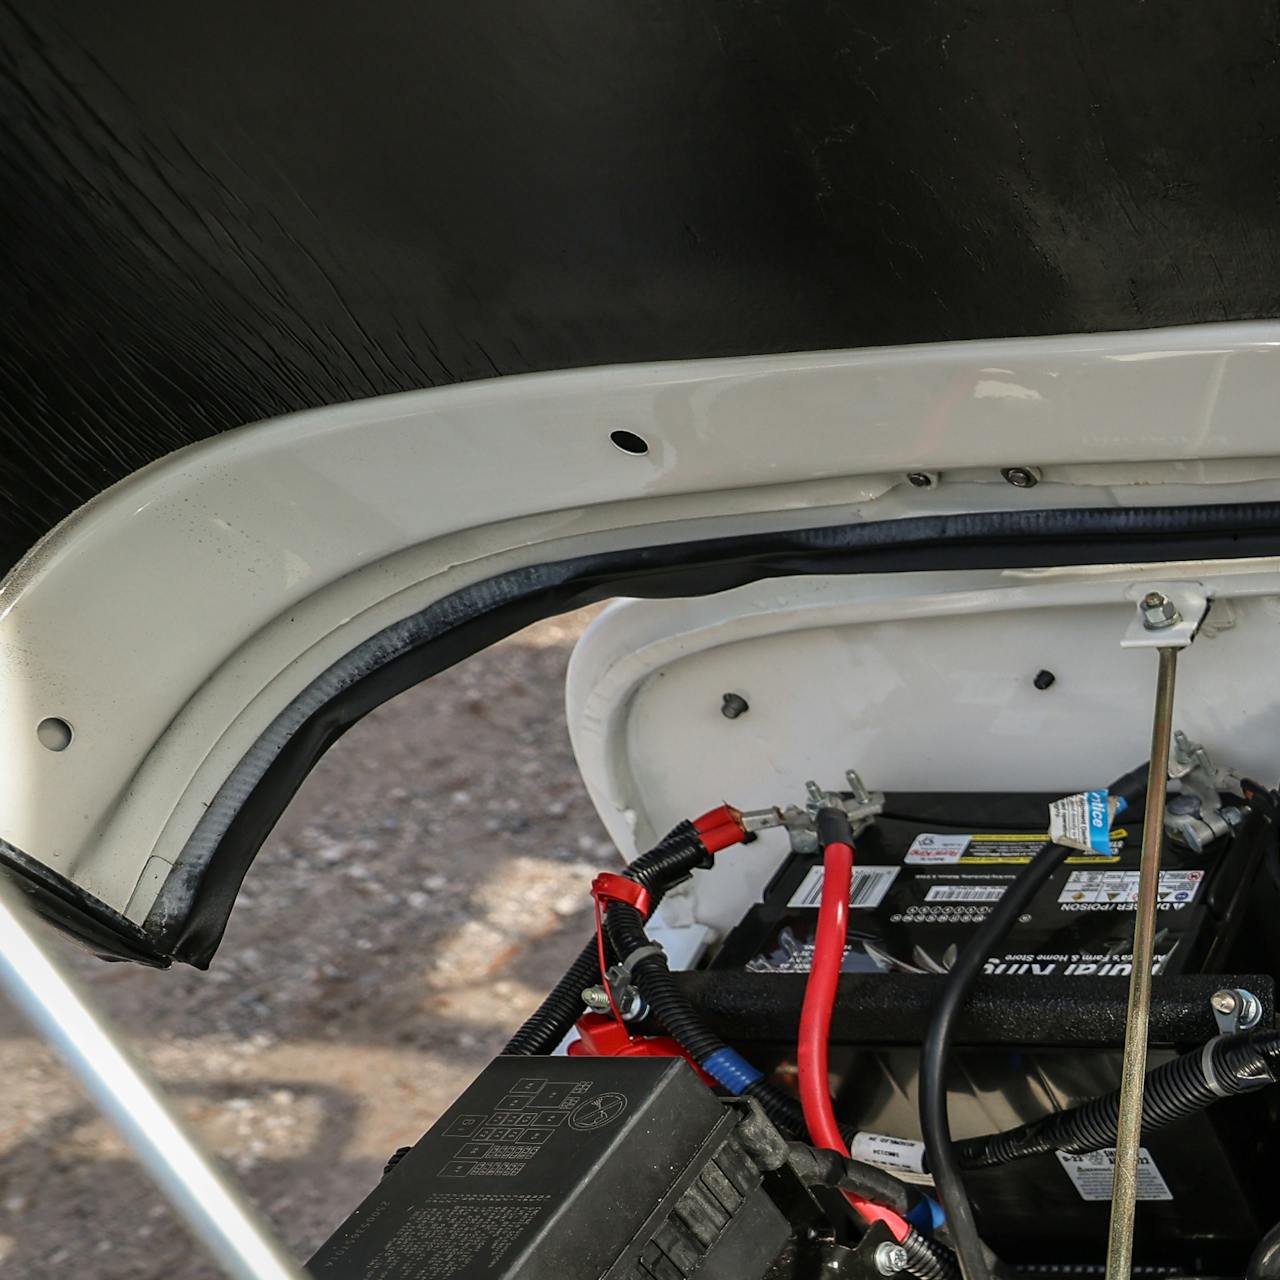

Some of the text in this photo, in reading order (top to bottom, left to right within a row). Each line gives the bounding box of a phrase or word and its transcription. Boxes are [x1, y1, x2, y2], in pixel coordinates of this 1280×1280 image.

[1116, 903, 1170, 911] DAER
[1005, 954, 1035, 962] Store
[1036, 954, 1068, 962] Home
